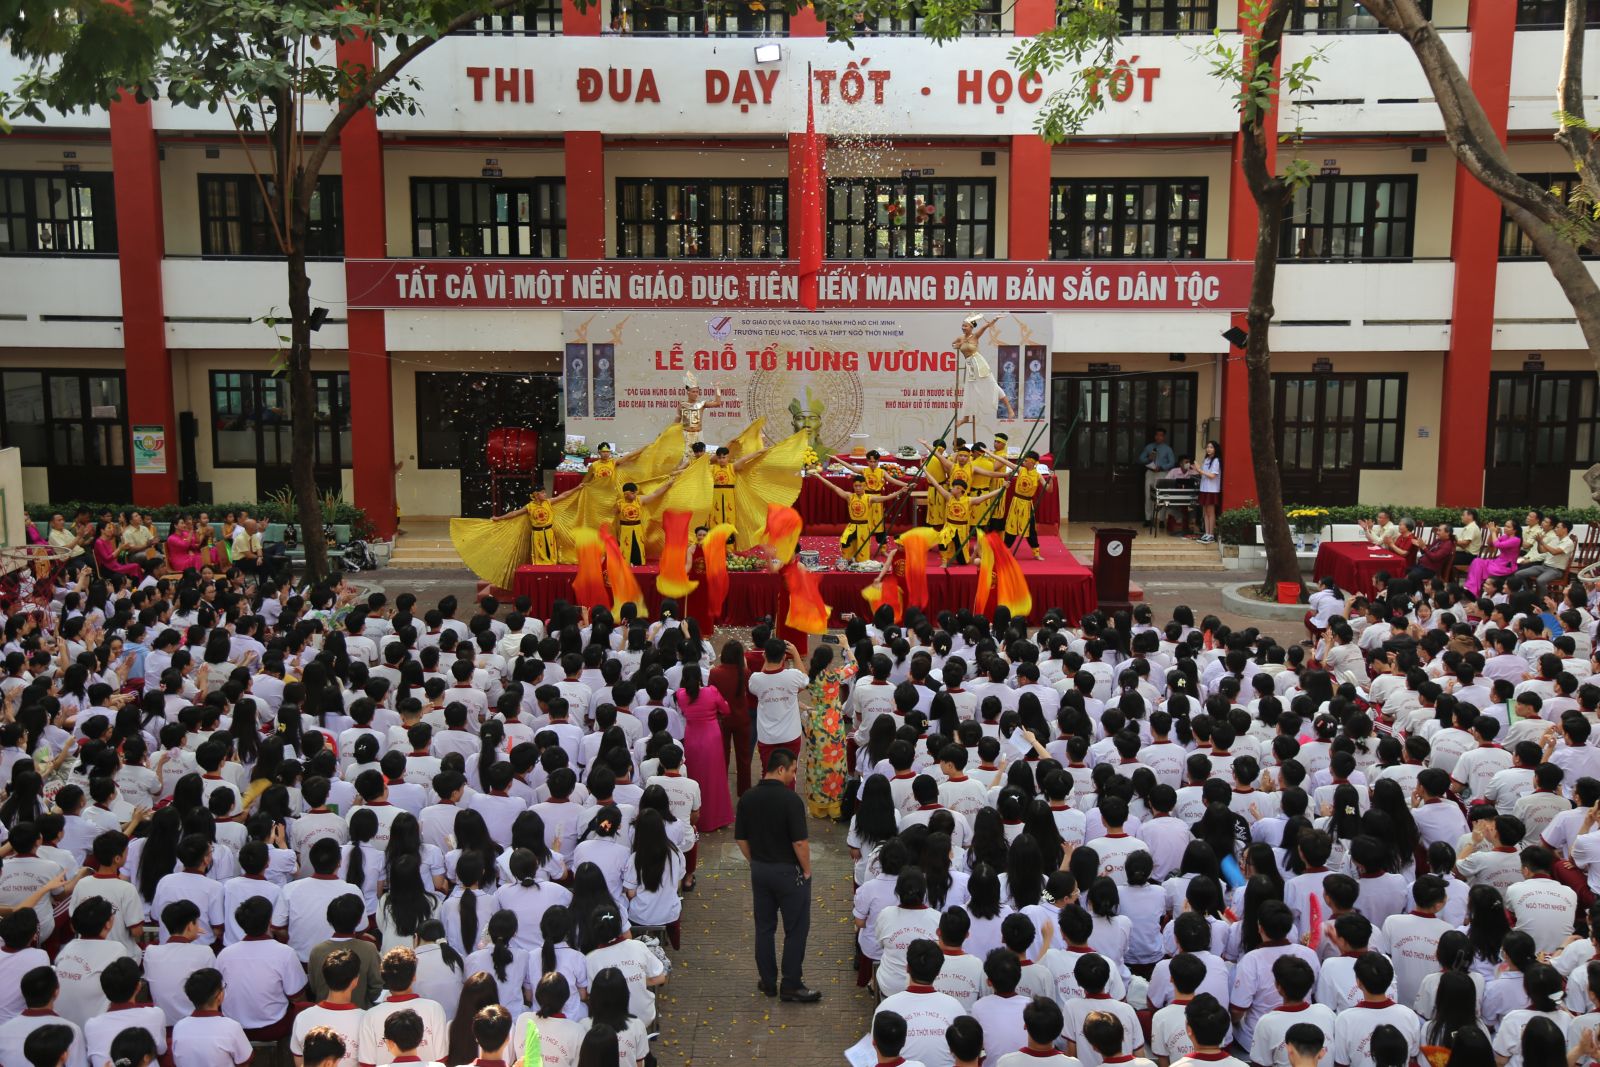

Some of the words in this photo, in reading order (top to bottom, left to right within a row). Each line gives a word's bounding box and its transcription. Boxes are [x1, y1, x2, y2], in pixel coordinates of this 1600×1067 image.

[466, 67, 534, 103] THI
[576, 67, 661, 102] ĐUA
[706, 69, 780, 113] DẠY
[812, 57, 892, 104] TỐT
[957, 69, 1043, 113] HỌC
[395, 265, 437, 299] TẤT
[445, 266, 477, 299] CẢ
[484, 270, 506, 299] VÌ
[513, 270, 566, 305] MỘT
[572, 267, 621, 300] NỀN
[629, 269, 684, 300] GIÁO
[691, 275, 739, 305] DỤC
[746, 270, 799, 300] TIÊN
[816, 268, 858, 300] IẾN
[866, 275, 936, 301] MANG
[943, 271, 998, 306] ĐẬM
[1006, 267, 1055, 301] BẢN
[1062, 267, 1109, 301] SẮC
[1117, 271, 1168, 301] DÂN
[1174, 271, 1219, 307] TỘC
[752, 318, 768, 326] GIÁO
[792, 318, 806, 326] ĐÀO
[734, 328, 763, 336] TRƯỜNG
[819, 328, 828, 336] VÀ
[848, 328, 863, 336] NGÔ
[865, 328, 882, 337] THỜI
[655, 343, 684, 371] LỄ
[694, 343, 737, 371] GIỖ
[746, 342, 779, 371] TỔ
[787, 346, 859, 371] HÙNG
[867, 349, 956, 372] VƯƠNG
[907, 1027, 916, 1037] GÔ
